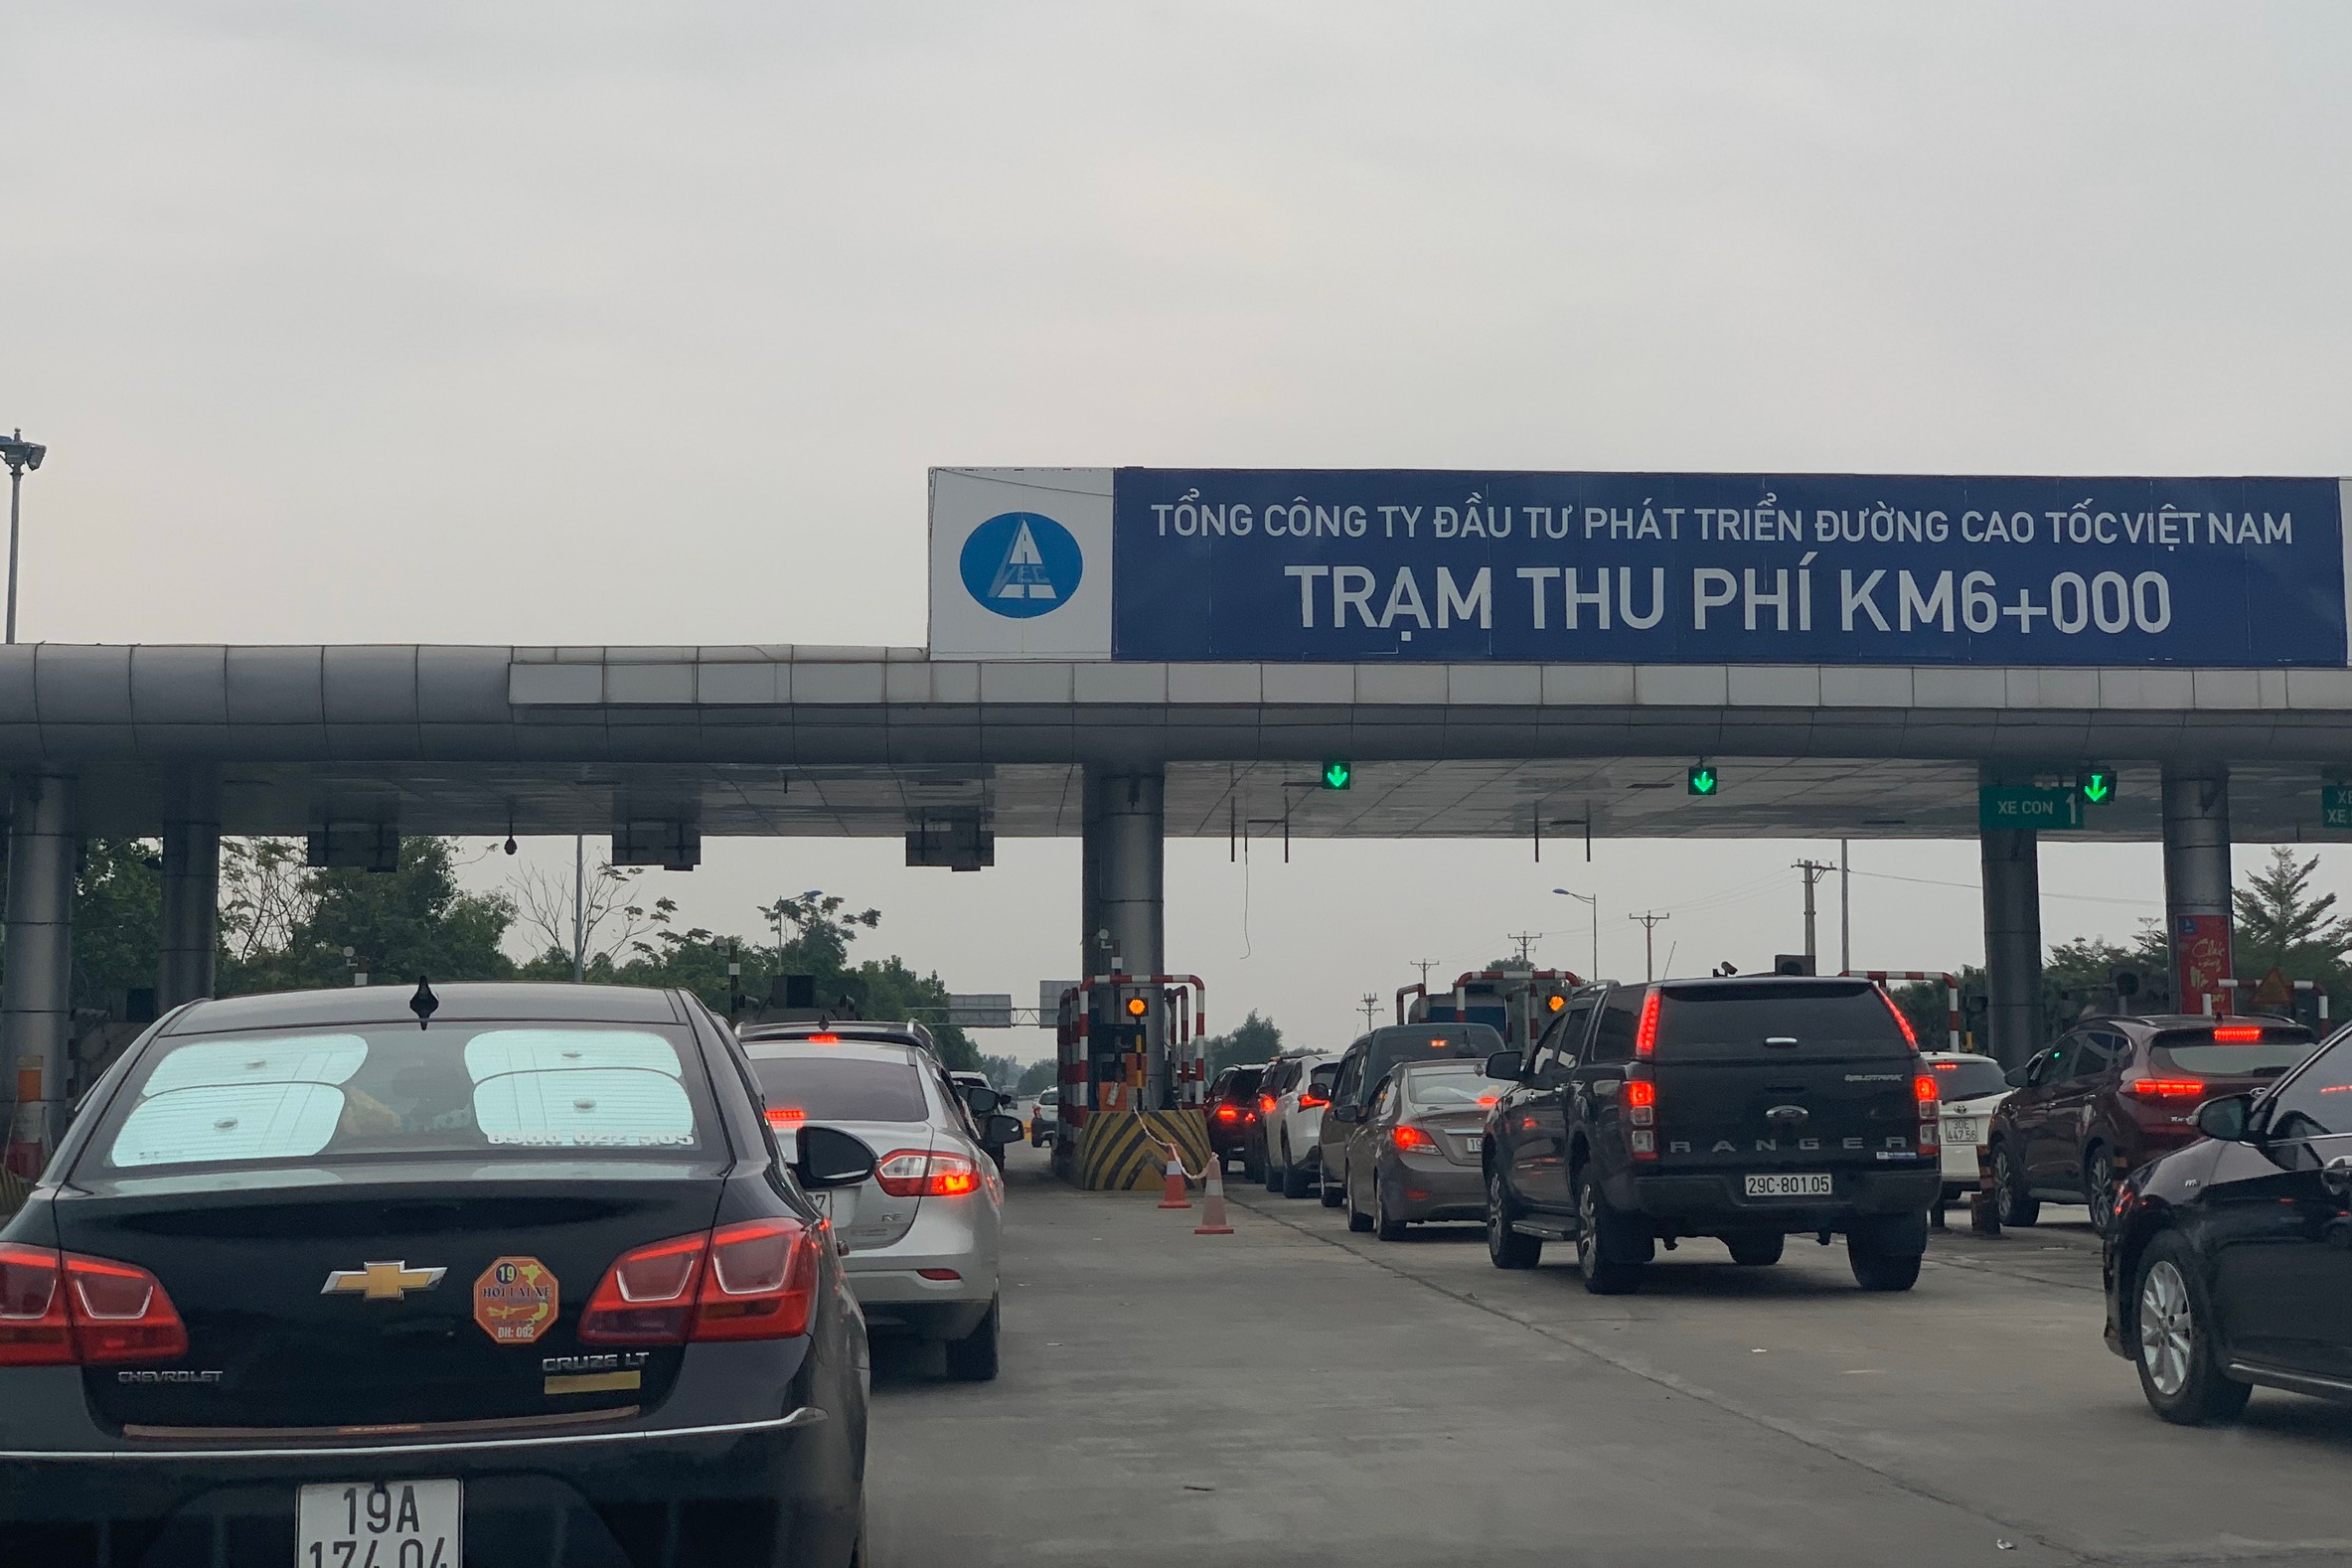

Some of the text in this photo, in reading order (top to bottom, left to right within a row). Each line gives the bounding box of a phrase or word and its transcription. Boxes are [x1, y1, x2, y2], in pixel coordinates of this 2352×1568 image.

[1151, 488, 2292, 551] TỔNG CÔNG TY ĐẦU TƯ PHÁT TRIỂN ĐƯỜNG CAO TỐC VIỆT NAM
[1285, 551, 2172, 642] TRẠM THU PHÍ KM6+000
[1997, 800, 2054, 815] XE CON
[2065, 793, 2077, 825] 1
[1669, 1136, 1908, 1155] RANGER
[1747, 1176, 1831, 1195] 29C-801.05
[498, 1265, 516, 1282] 19
[516, 1327, 535, 1338] 092
[542, 1351, 650, 1372] CRUZE LT
[117, 1370, 224, 1382] CHEVROLET
[343, 1485, 420, 1535] 19A
